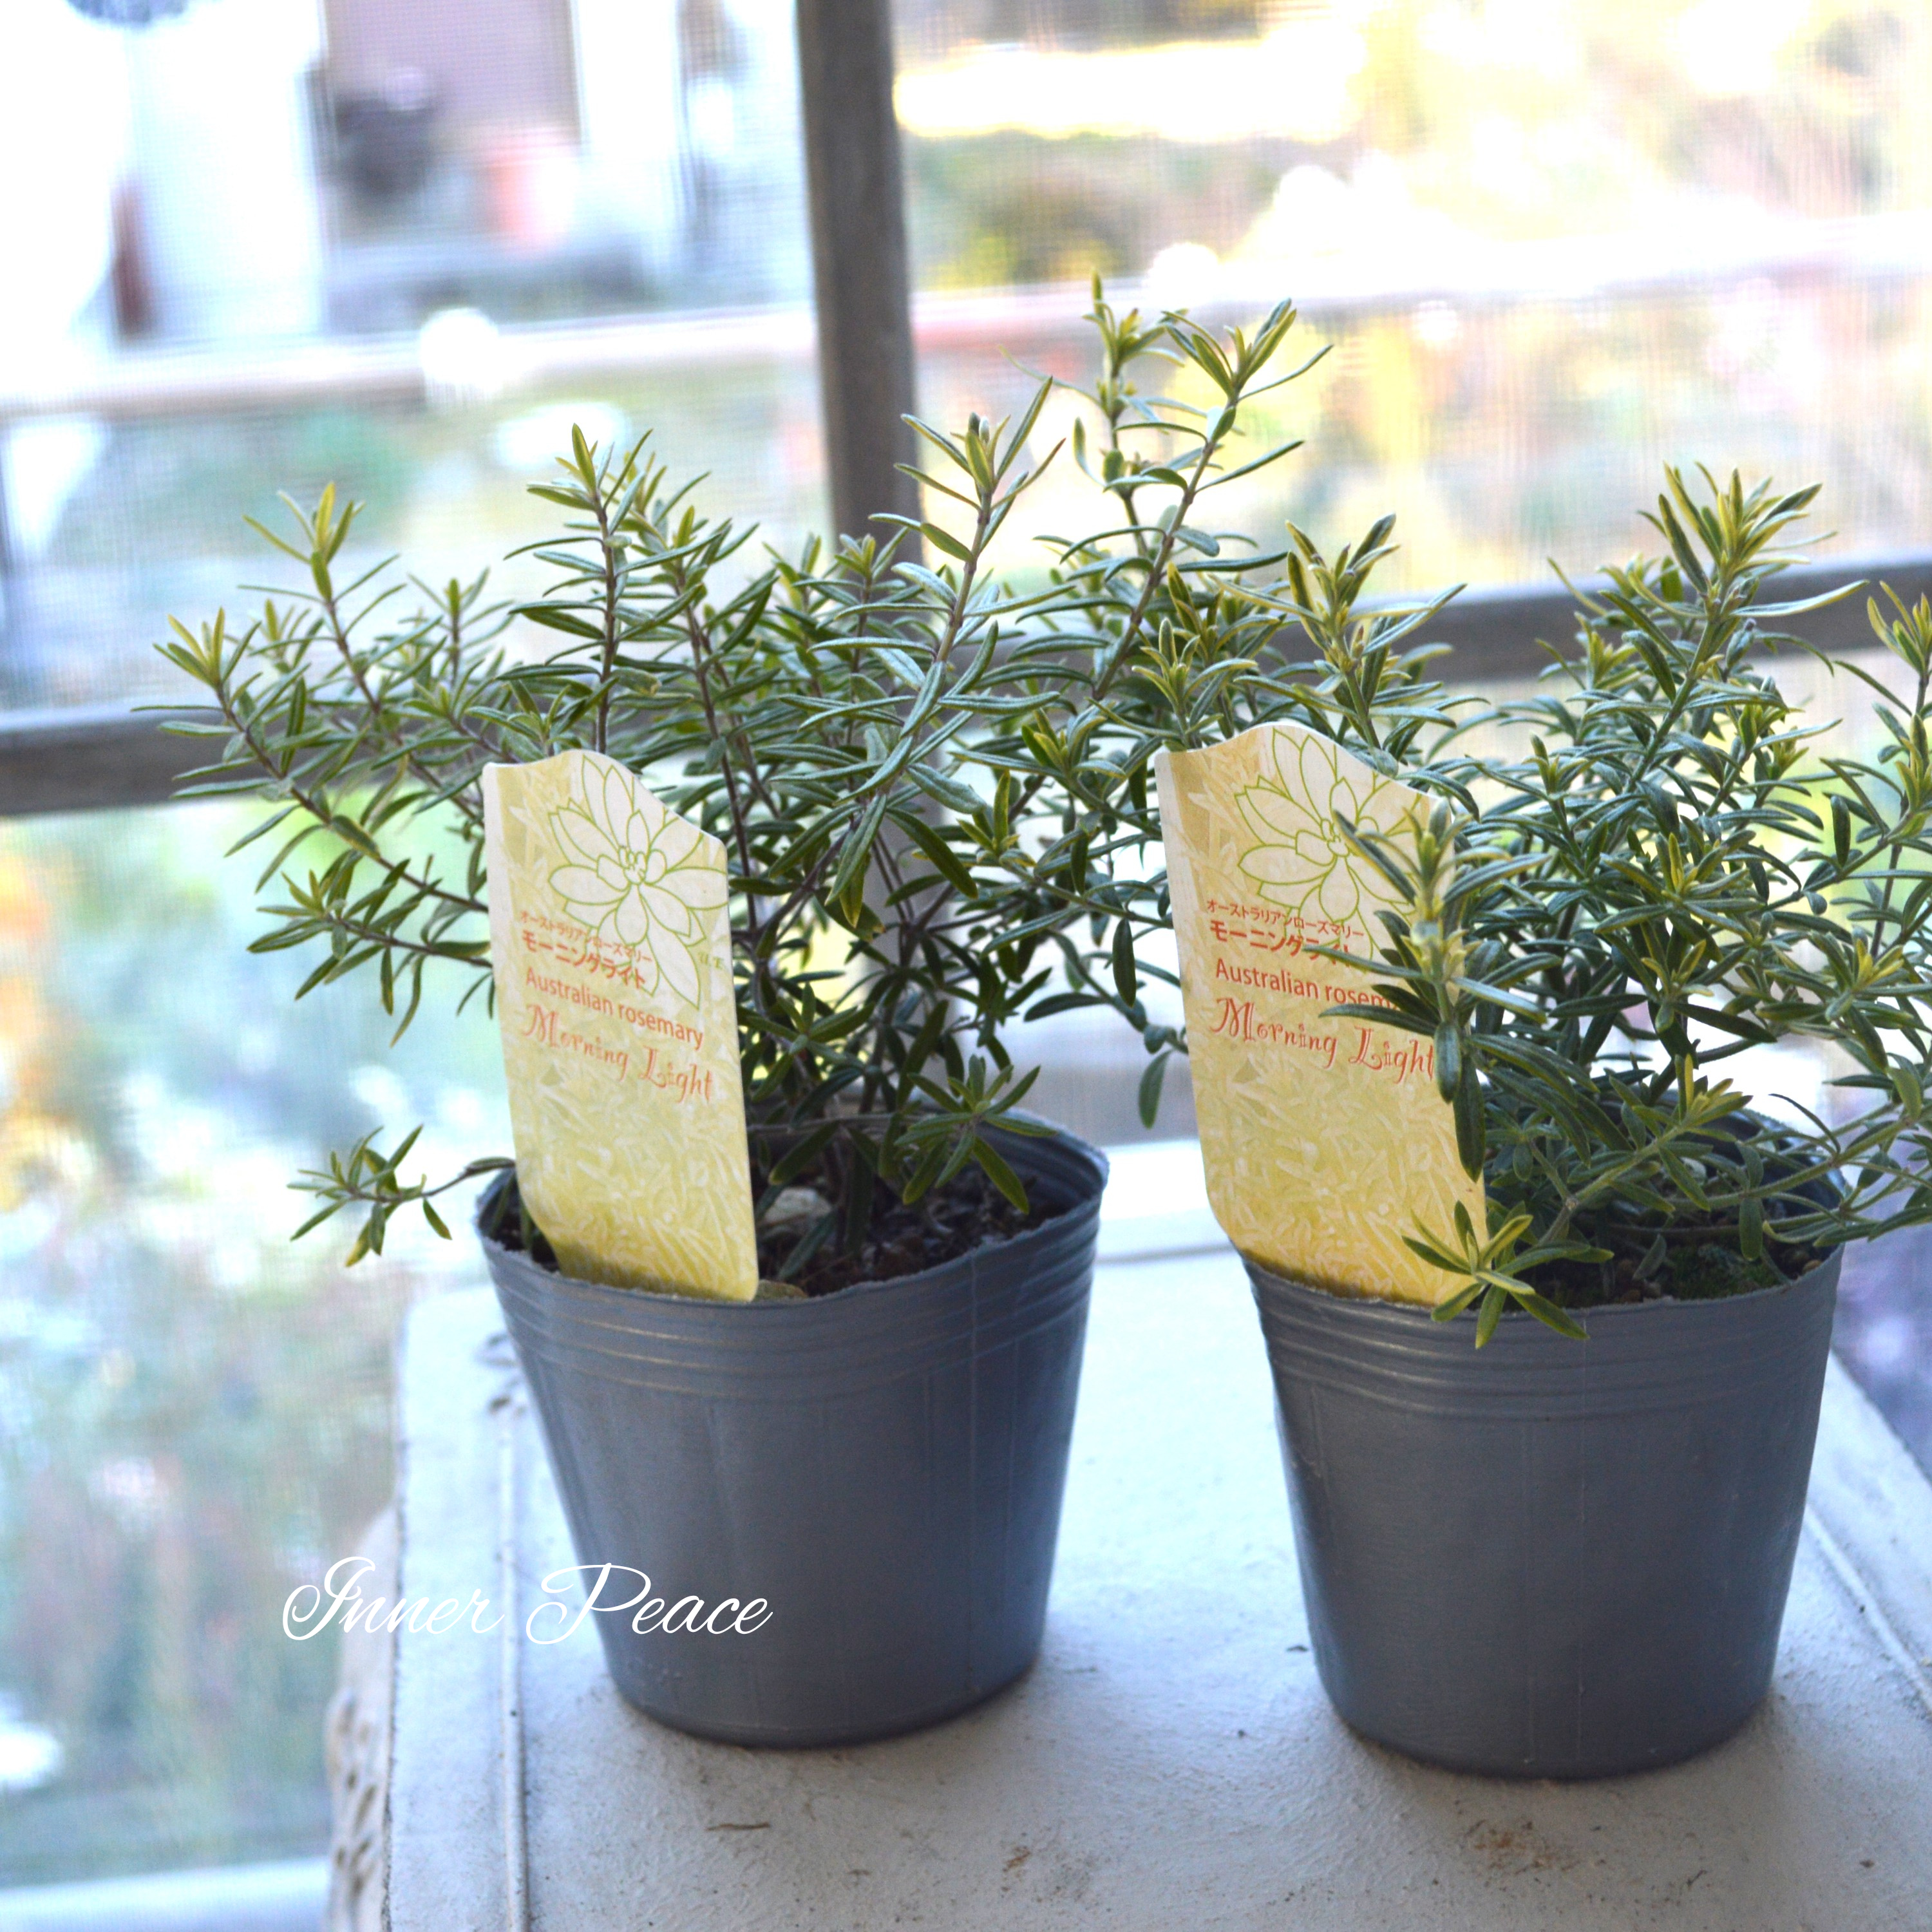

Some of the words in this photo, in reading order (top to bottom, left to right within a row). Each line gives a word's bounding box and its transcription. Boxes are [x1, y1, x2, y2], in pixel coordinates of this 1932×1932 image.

[1206, 899, 1364, 938] オーストラリアンローズマリー
[522, 929, 646, 989] モーニングライト
[1215, 957, 1319, 999] Australian
[1325, 985, 1399, 1010] rosem
[526, 967, 613, 1016] Australian
[618, 1005, 704, 1051] rosemary
[1209, 998, 1338, 1069] Morning
[1349, 1025, 1434, 1084] Light
[523, 1003, 630, 1082] Morning
[638, 1045, 714, 1104] Light
